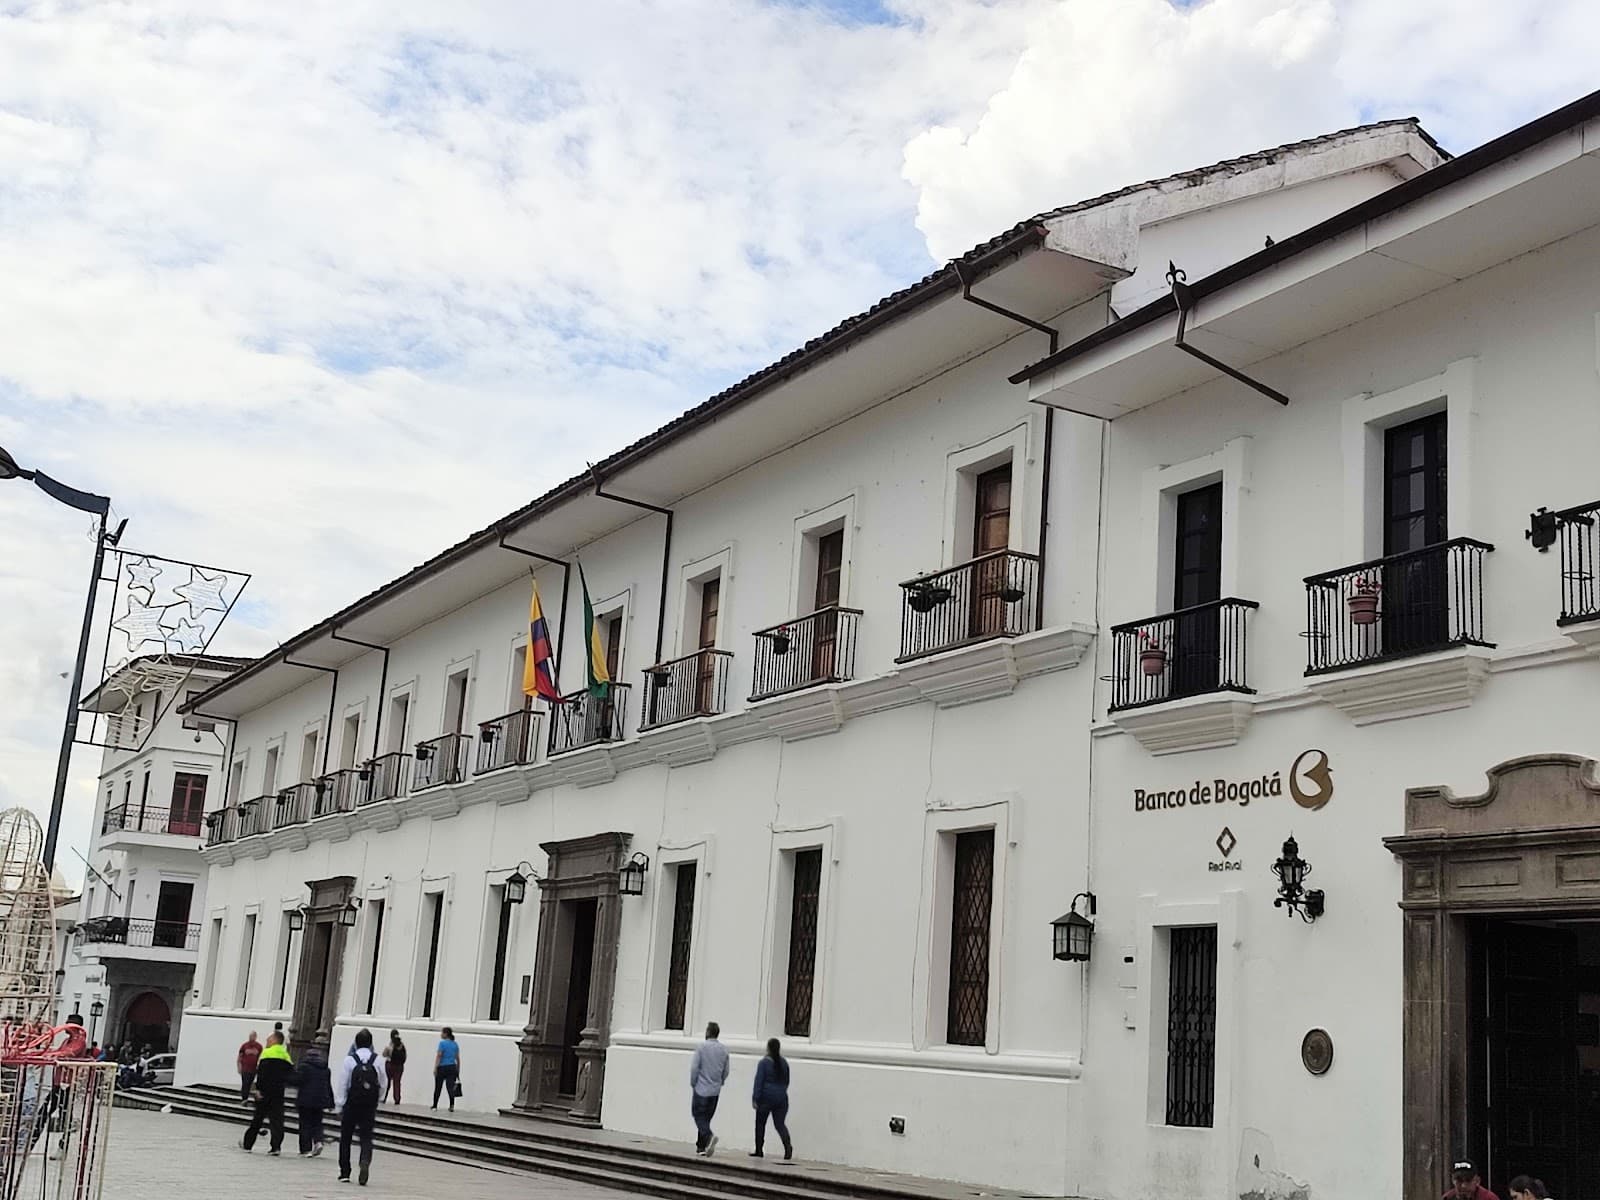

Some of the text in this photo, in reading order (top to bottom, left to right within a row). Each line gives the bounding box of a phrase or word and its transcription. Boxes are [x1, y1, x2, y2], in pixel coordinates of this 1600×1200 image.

[1134, 771, 1282, 812] Banco de Bogotá
[1208, 860, 1224, 872] Red
